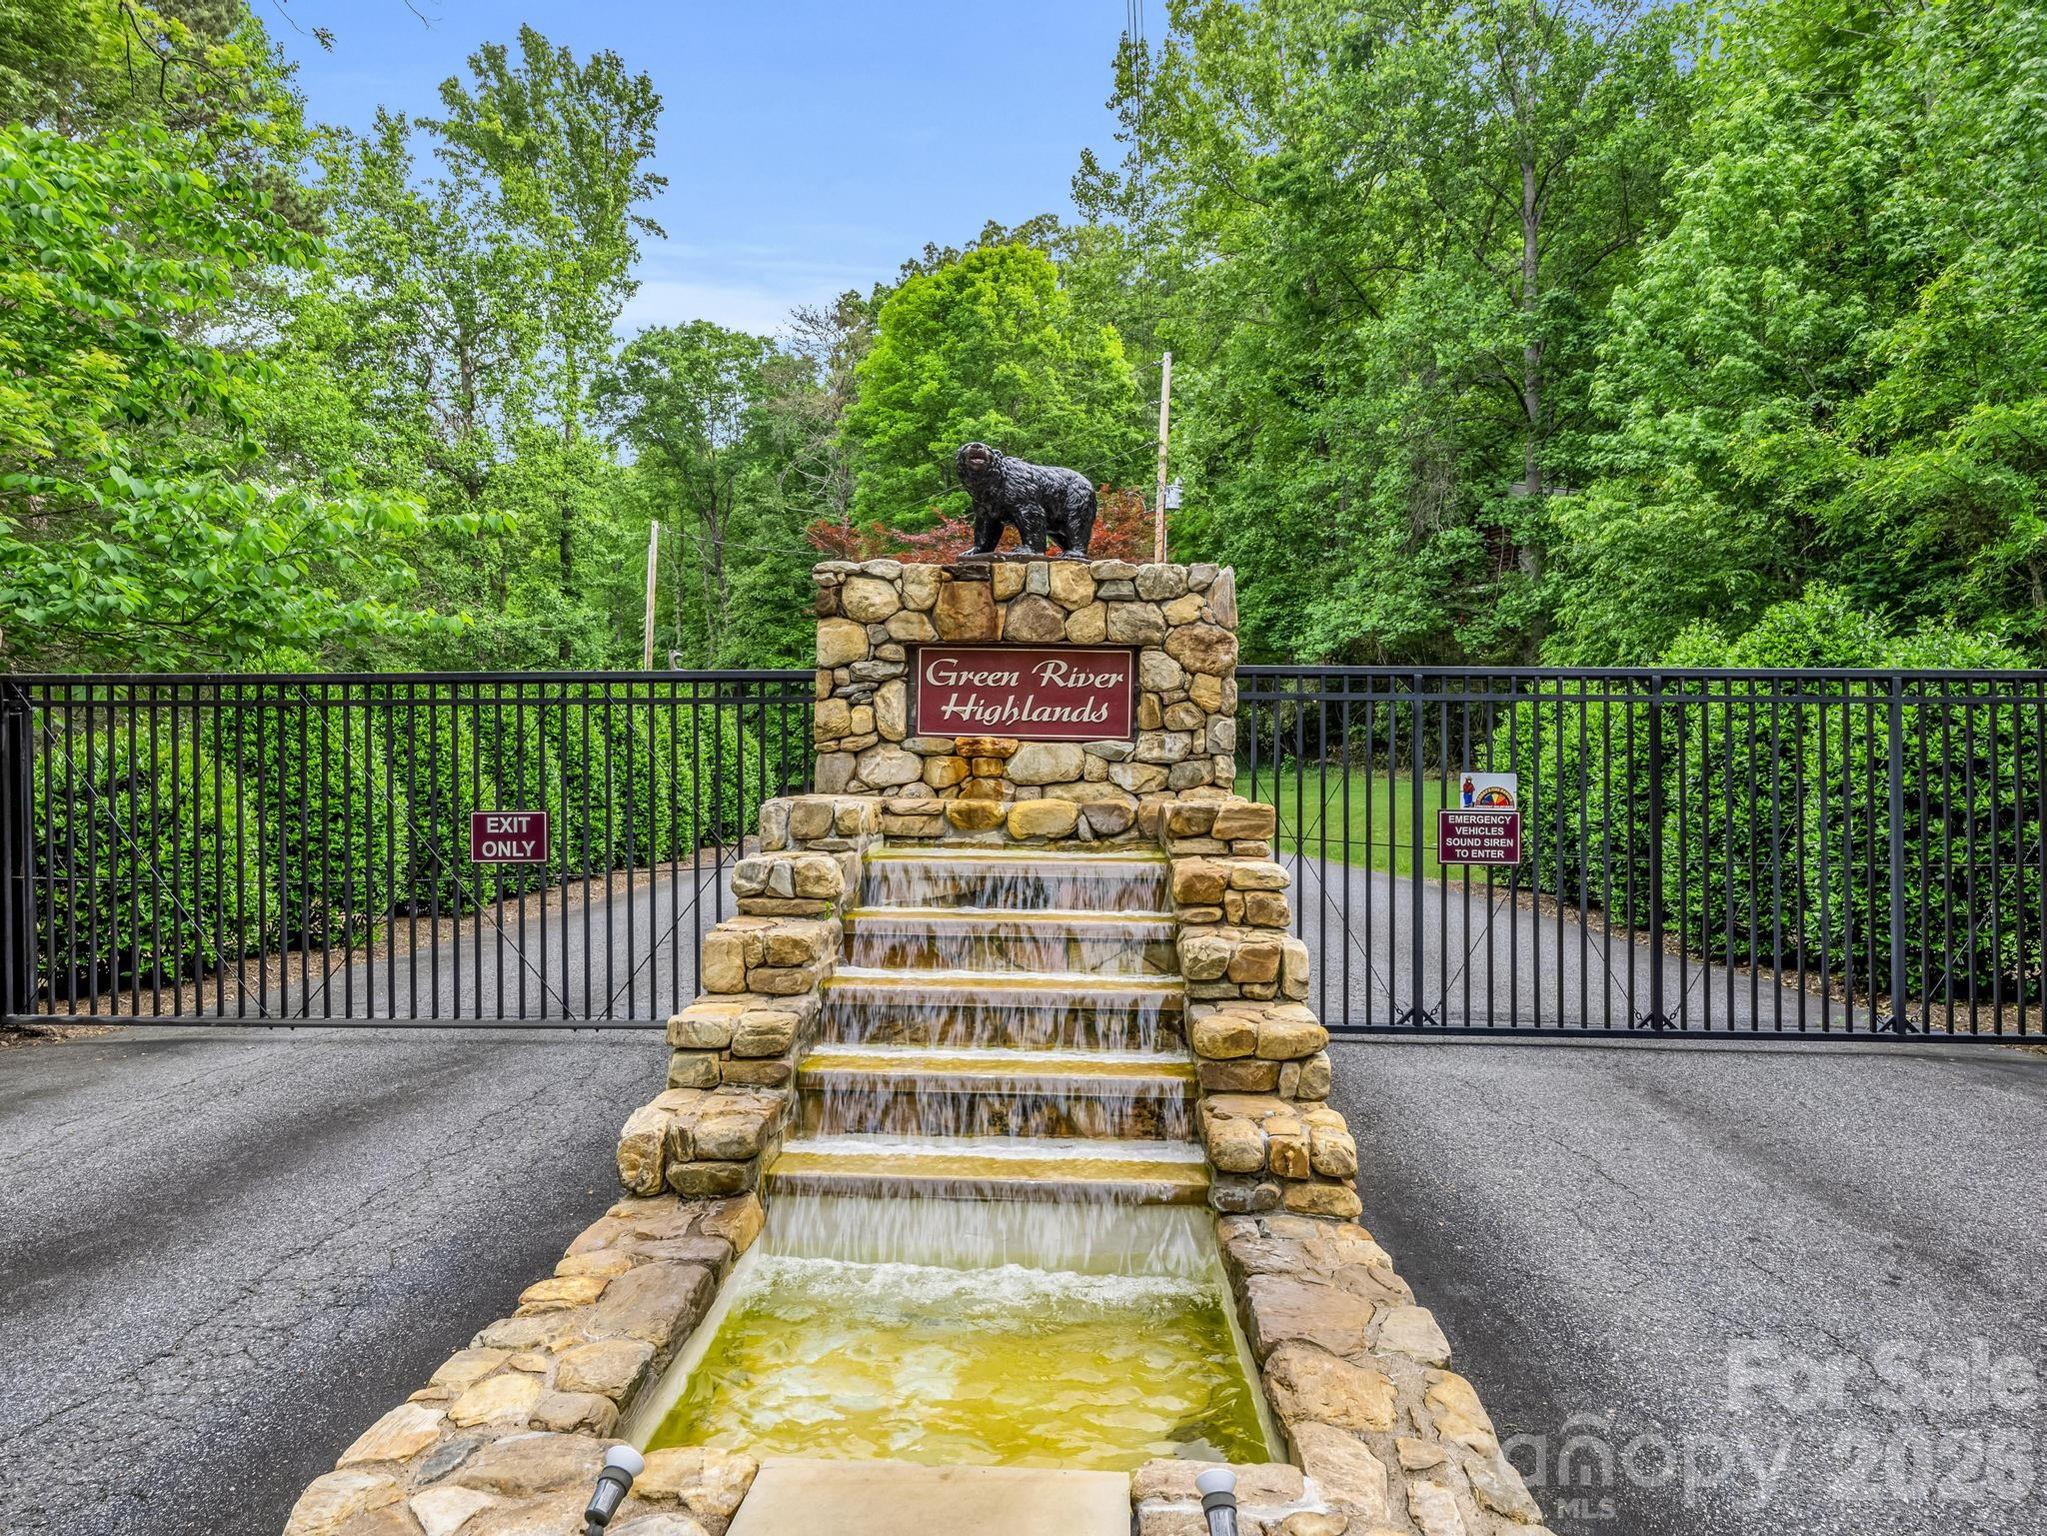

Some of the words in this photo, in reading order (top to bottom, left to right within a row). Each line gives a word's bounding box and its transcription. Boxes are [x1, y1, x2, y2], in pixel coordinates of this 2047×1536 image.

[926, 658, 1019, 687] Green
[1032, 659, 1124, 688] River
[941, 693, 1109, 726] Highlands
[486, 816, 531, 833] EXIT
[1448, 815, 1512, 824] EMERGENCY
[1455, 826, 1504, 835] VEHICLES
[481, 840, 536, 857] ONLY
[1446, 837, 1481, 846] SOUND
[1483, 838, 1514, 847] SIREN
[1455, 849, 1469, 858] TO
[1471, 849, 1504, 858] ENTER
